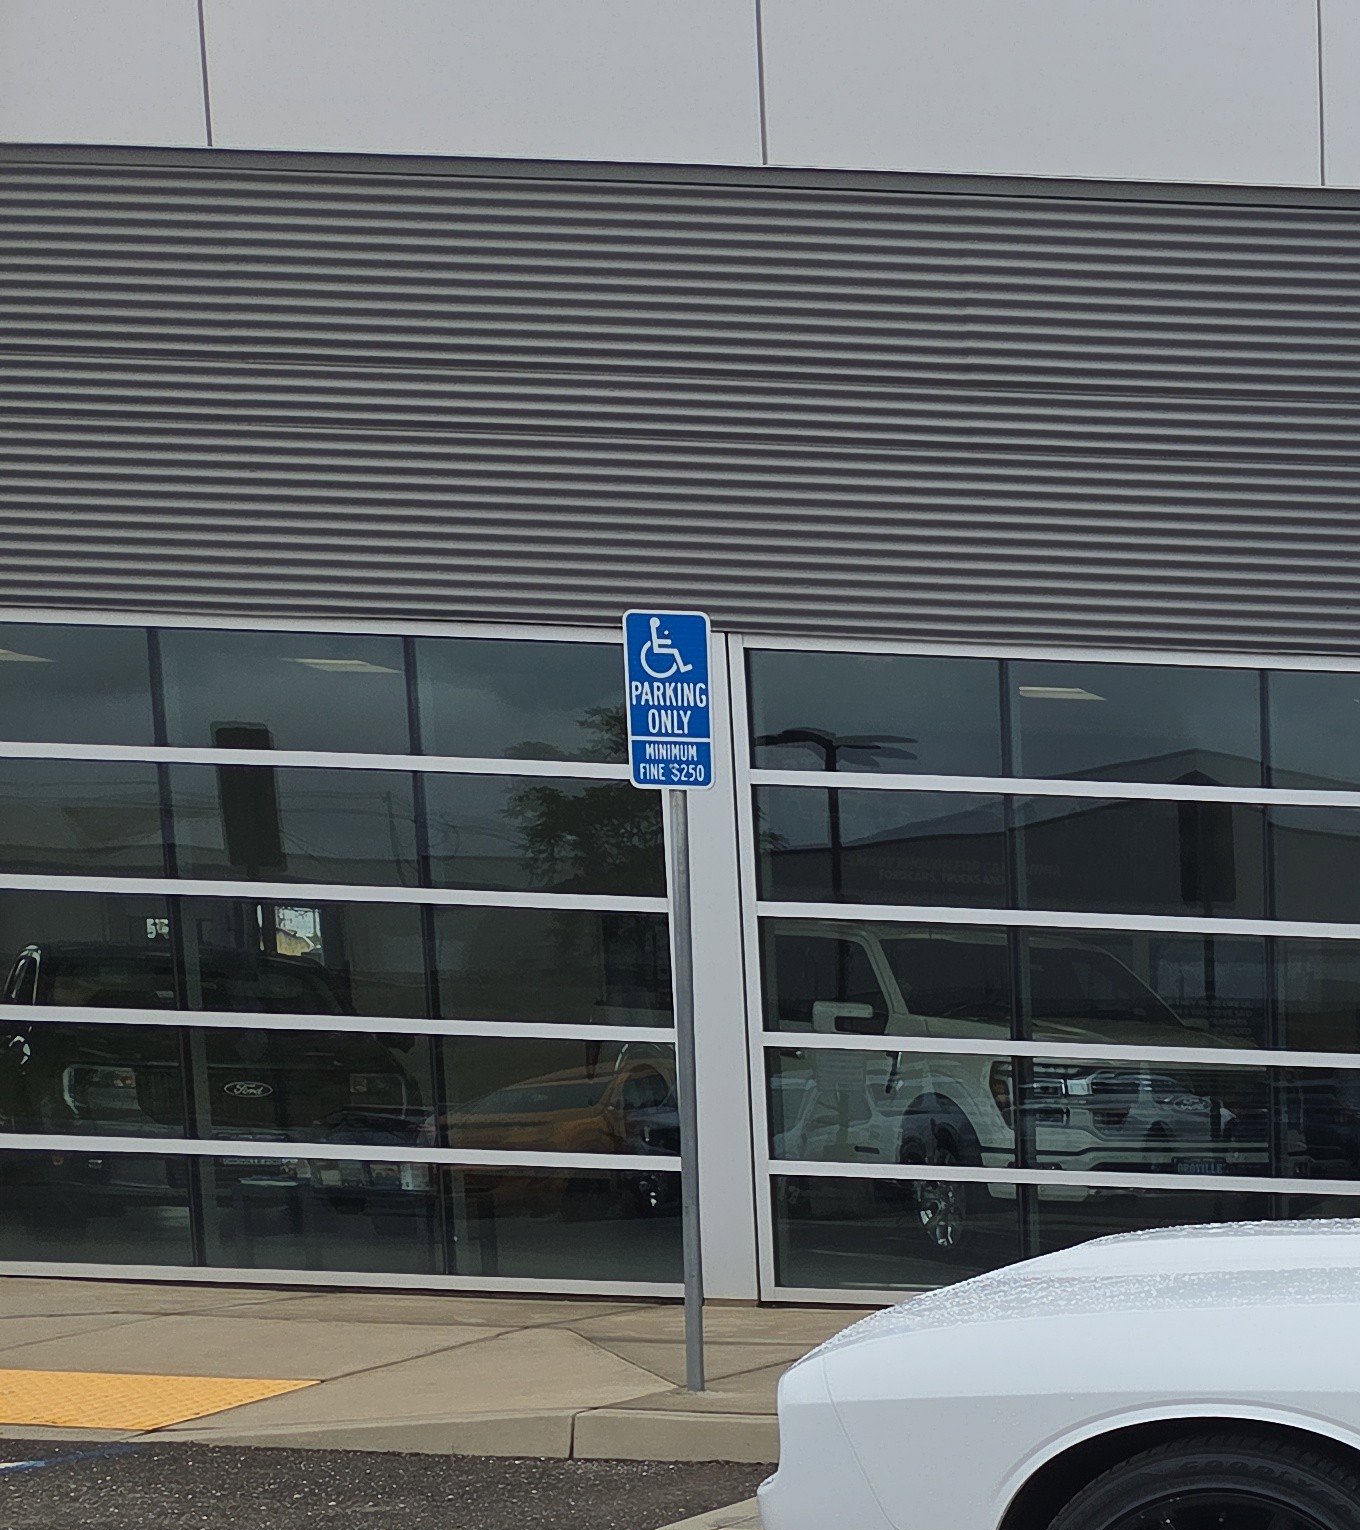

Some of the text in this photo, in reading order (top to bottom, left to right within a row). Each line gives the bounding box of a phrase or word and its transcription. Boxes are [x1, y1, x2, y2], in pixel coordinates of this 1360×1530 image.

[631, 681, 707, 708] PARKING
[648, 709, 692, 735] ONLY
[645, 743, 698, 761] MINIMUM
[639, 763, 705, 782] FINE $250
